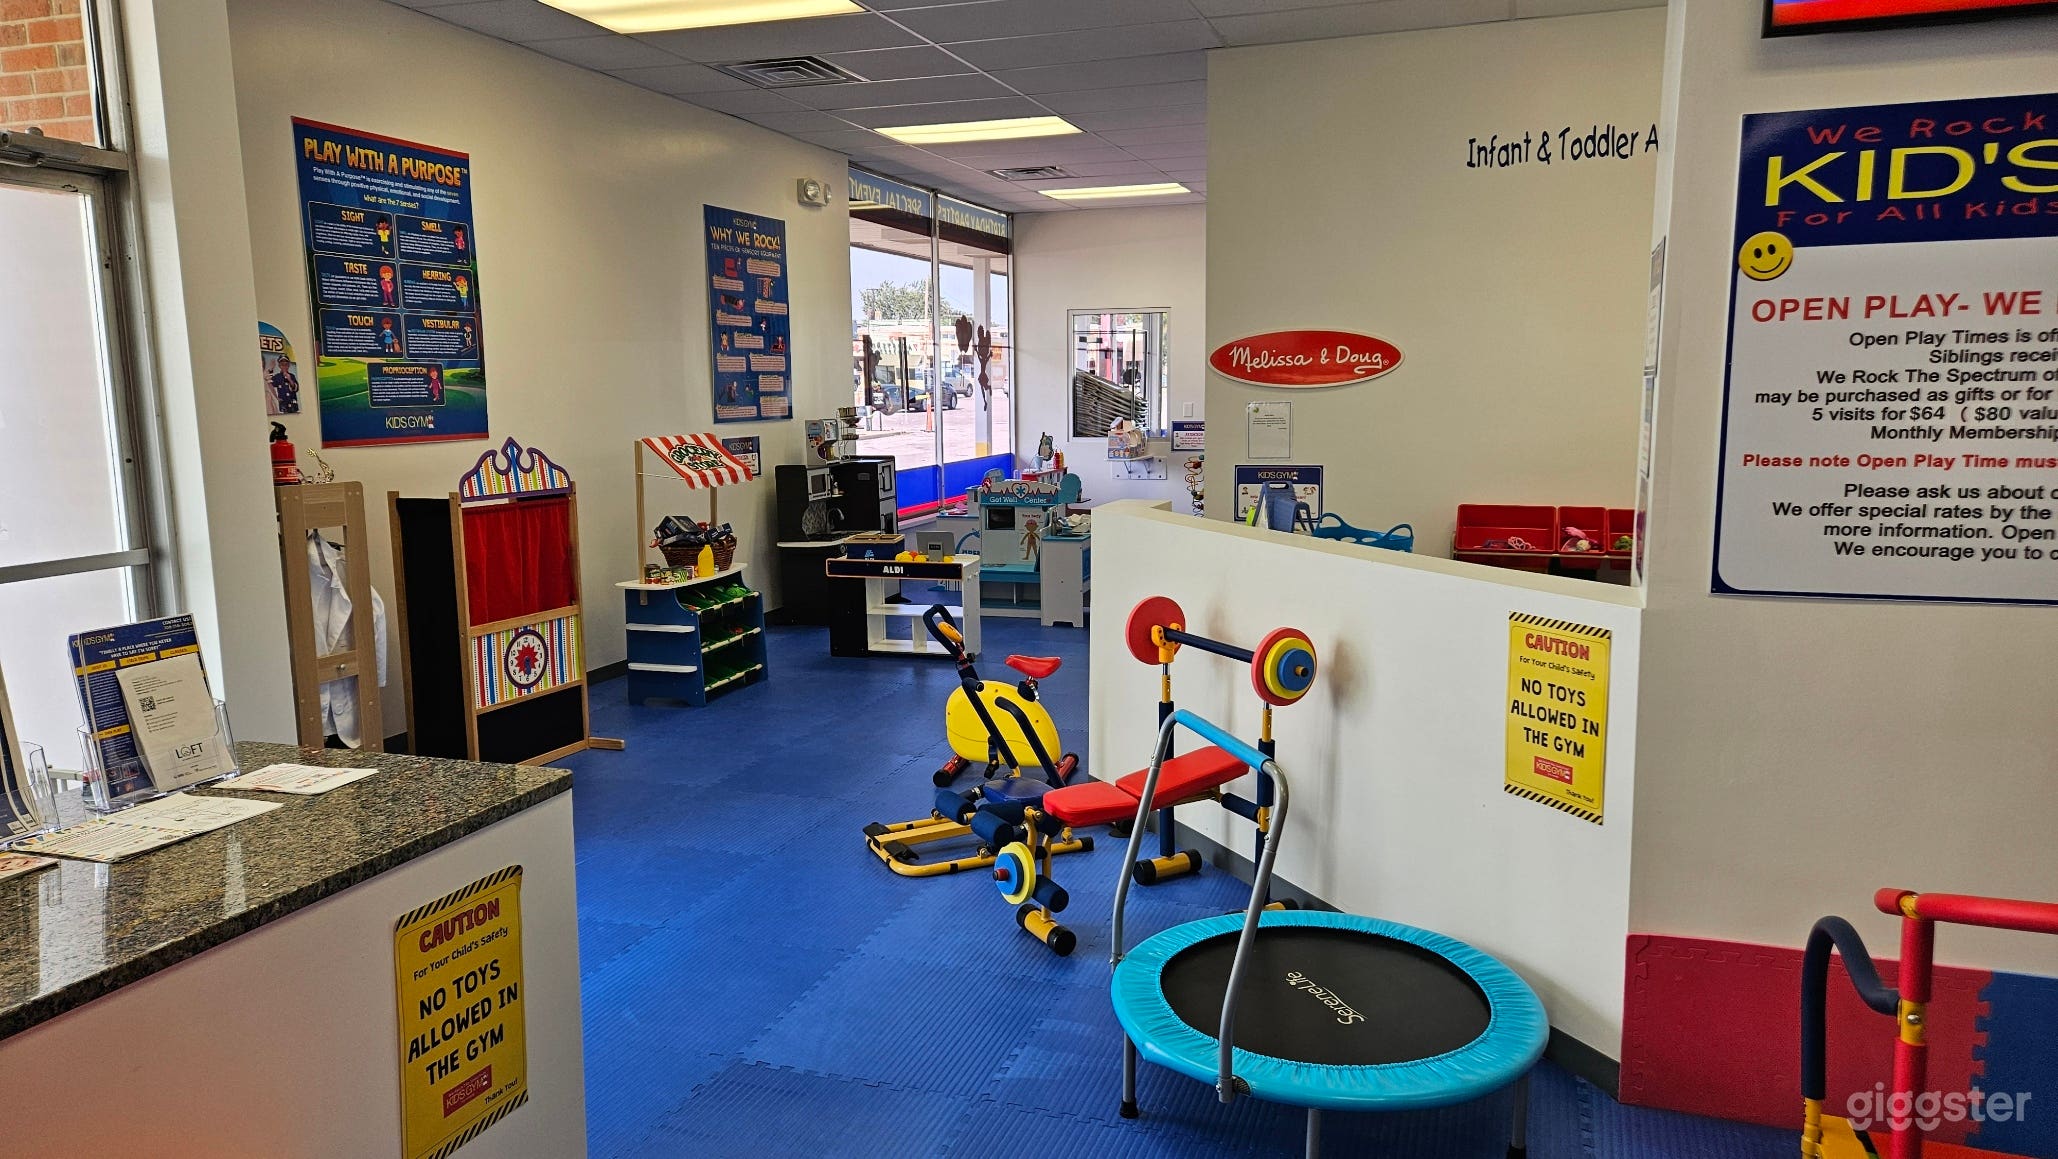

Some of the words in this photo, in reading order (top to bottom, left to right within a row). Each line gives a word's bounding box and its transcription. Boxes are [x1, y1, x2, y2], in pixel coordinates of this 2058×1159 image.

[1807, 124, 1882, 145] We
[1910, 111, 2047, 138] Rock
[1467, 131, 1531, 168] Infant
[1537, 131, 1551, 164] &
[1559, 123, 1638, 160] Toddler
[304, 138, 341, 165] PLAY
[346, 144, 384, 173] WITH
[388, 153, 398, 176] A
[341, 211, 364, 223] SIGHT
[1776, 211, 1852, 227] For
[1877, 203, 1941, 220] All
[1964, 197, 2058, 219] Kids
[422, 221, 442, 232] SMELL
[710, 226, 732, 243] WHY
[736, 231, 750, 246] WE
[754, 233, 780, 250] ROCK!
[344, 262, 367, 274] TASTE
[422, 270, 451, 281] HEARING
[1752, 297, 1850, 323] OPEN
[1983, 291, 2042, 315] WE
[347, 314, 374, 327] TOUCH
[422, 319, 459, 329] VESTIBULAR
[1849, 331, 1898, 348] Open
[1906, 331, 1946, 347] Play
[1953, 330, 2009, 344] Times
[2016, 329, 2030, 343] is
[2038, 328, 2058, 343] of
[1229, 346, 1312, 372] Melissa
[1320, 348, 1330, 364] &
[1929, 350, 2003, 366] Siblings
[2010, 349, 2058, 363] recei
[382, 366, 427, 375] PROPRIOCEPTION
[1816, 370, 1845, 384] We
[1852, 369, 1898, 383] Rock
[1906, 369, 1939, 383] The
[1947, 368, 2036, 385] Spectrum
[1755, 391, 1792, 406] may
[1798, 390, 1819, 403] be
[1825, 389, 1920, 405] purchased
[1927, 390, 1948, 402] as
[1955, 388, 1994, 404] gifts
[2001, 390, 2020, 401] or
[2027, 387, 2052, 401] for
[1812, 408, 1823, 421] 5
[1829, 407, 1874, 421] visits
[1881, 407, 1906, 421] for
[1909, 406, 1945, 421] $64
[1974, 406, 2011, 421] $80
[1871, 426, 1943, 442] Monthly
[1743, 454, 1803, 467] Please
[1809, 455, 1850, 467] note
[1857, 454, 1907, 470] Open
[1914, 454, 1955, 470] Play
[1962, 454, 2008, 468] Time
[2016, 455, 2058, 468] mus
[1844, 484, 1909, 498] Please
[1917, 484, 1950, 498] ask
[1958, 486, 1980, 499] us
[1988, 484, 2044, 500] about
[1772, 502, 1803, 516] We
[1809, 502, 1852, 517] offer
[1859, 503, 1926, 520] special
[1934, 505, 1982, 519] rates
[1990, 505, 2012, 522] by
[2020, 505, 2050, 520] the
[1824, 524, 1871, 537] more
[1878, 524, 1992, 539] information.
[2002, 525, 2055, 543] Open
[1834, 542, 1865, 556] We
[1872, 543, 1974, 561] encourage
[1981, 545, 2016, 561] you
[2024, 545, 2042, 559] to
[883, 566, 903, 574] ALDI
[1525, 633, 1590, 661] CAUTION
[1519, 656, 1530, 664] For
[1532, 658, 1547, 668] Your
[1549, 662, 1570, 673] Child's
[1572, 667, 1595, 680] Safety
[1521, 677, 1542, 695] NO
[1547, 683, 1586, 707] TOYS
[1511, 699, 1576, 730] ALLOWED
[1582, 718, 1600, 737] IN
[1523, 726, 1548, 747] THE
[1553, 735, 1585, 758] GYM
[419, 897, 500, 953] CAUTION
[413, 967, 428, 982] For
[429, 953, 450, 973] Your
[452, 939, 479, 960] Child's
[481, 926, 508, 946] Safety
[419, 987, 446, 1021] NO
[452, 959, 501, 1000] TOYS
[1286, 971, 1365, 1025] SereneLife
[407, 1001, 492, 1064] ALLOWED
[498, 982, 518, 1010] IN
[425, 1052, 460, 1086] THE
[466, 1023, 504, 1062] GYM
[484, 1087, 503, 1104] Thank
